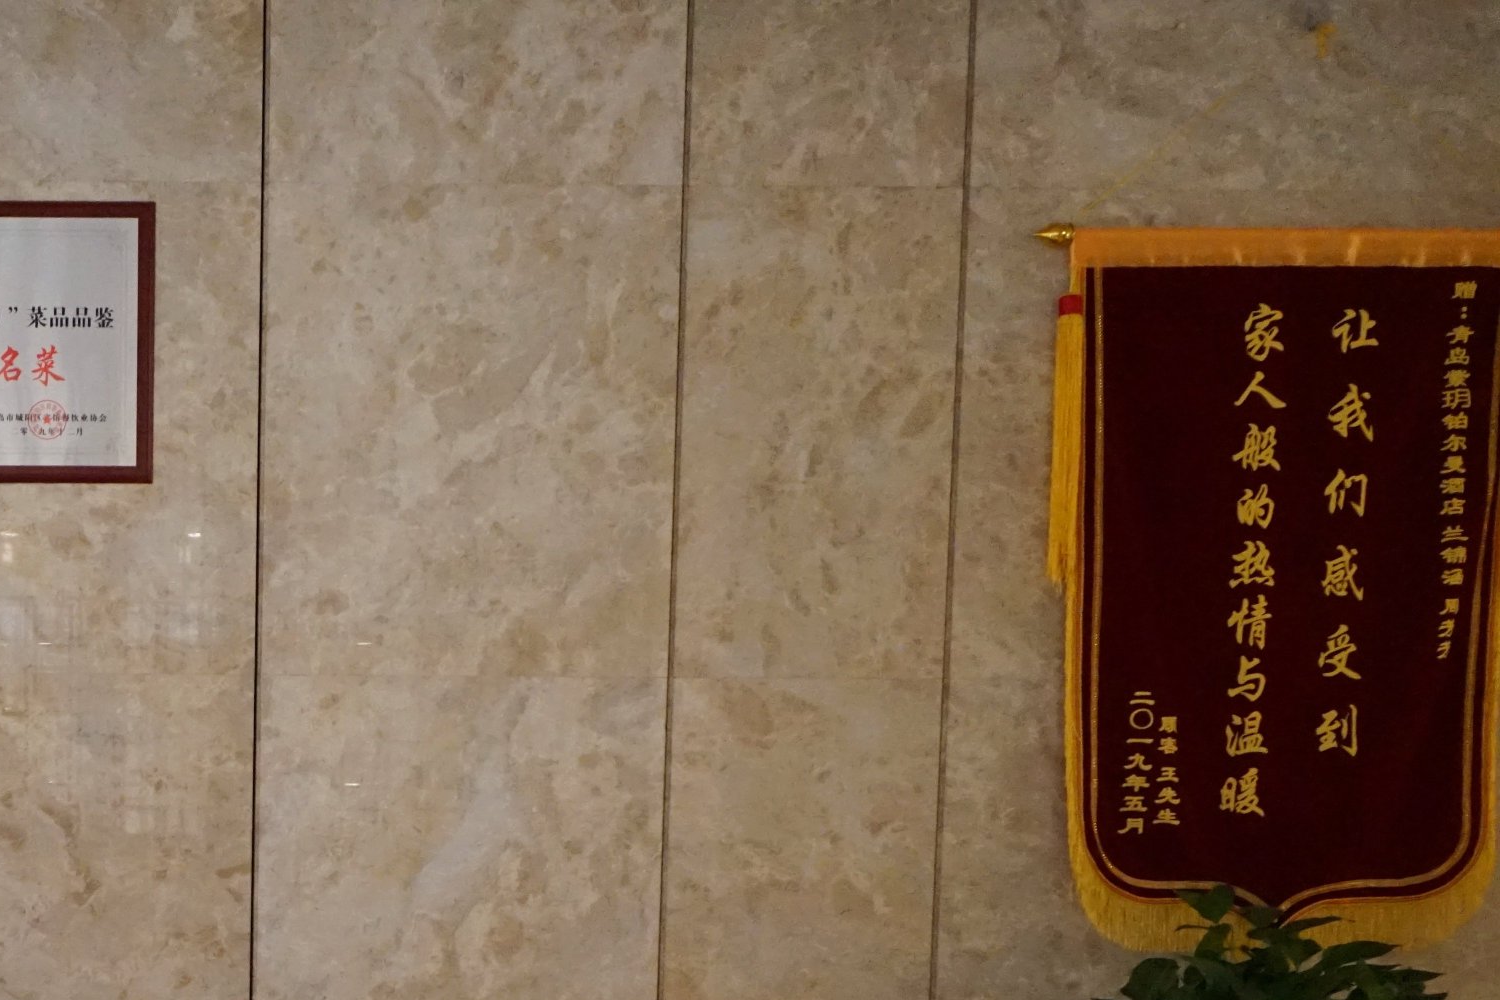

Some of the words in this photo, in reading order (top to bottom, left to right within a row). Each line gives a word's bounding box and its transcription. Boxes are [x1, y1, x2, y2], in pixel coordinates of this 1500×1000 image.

[1219, 302, 1287, 817] 家人般的热情与温暖
[1315, 308, 1380, 757] 让我们感受到
[1152, 765, 1181, 827] 王先生
